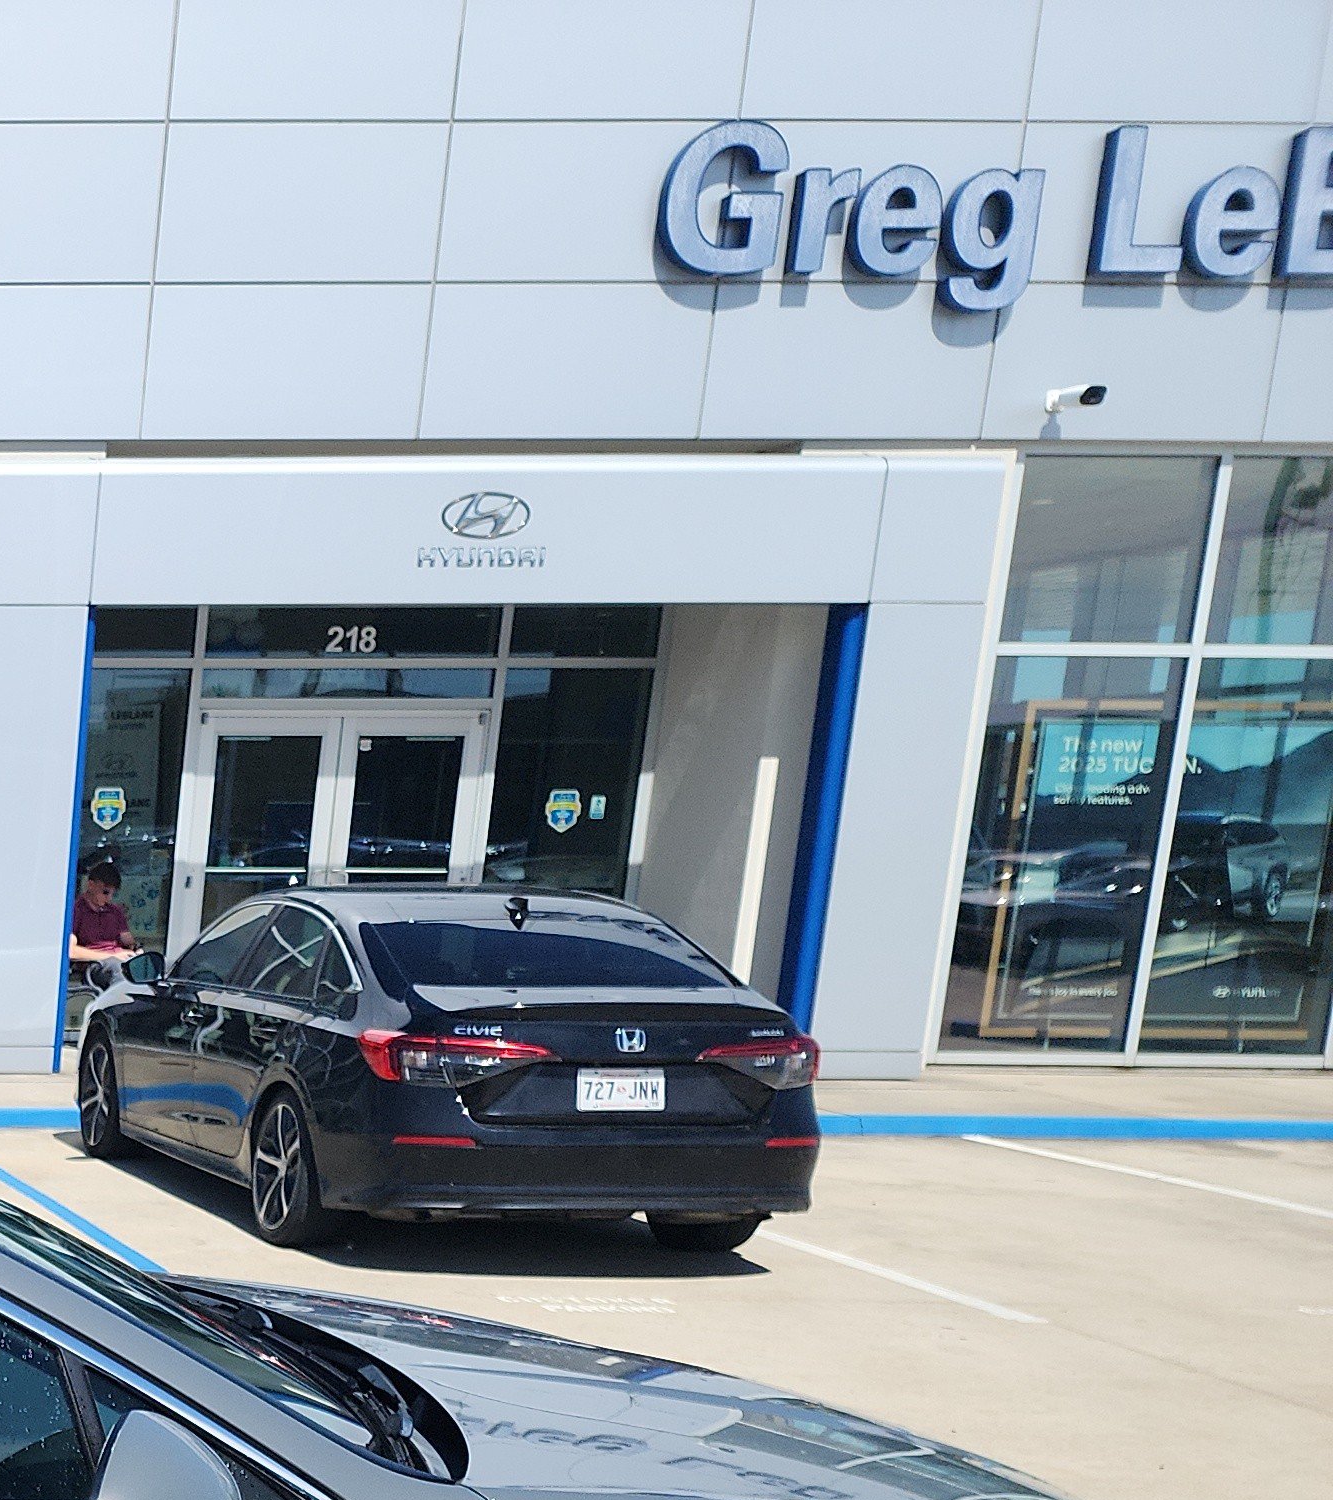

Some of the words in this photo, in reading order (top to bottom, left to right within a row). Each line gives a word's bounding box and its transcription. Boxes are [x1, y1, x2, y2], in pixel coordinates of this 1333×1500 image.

[655, 119, 1047, 312] Greg
[416, 546, 547, 568] HYUNDAI
[325, 626, 377, 653] 218
[1101, 738, 1143, 754] new
[1058, 757, 1106, 773] 2025
[454, 1025, 503, 1036] CIVIC
[584, 1081, 615, 1101] 727
[628, 1081, 660, 1101] JNW
